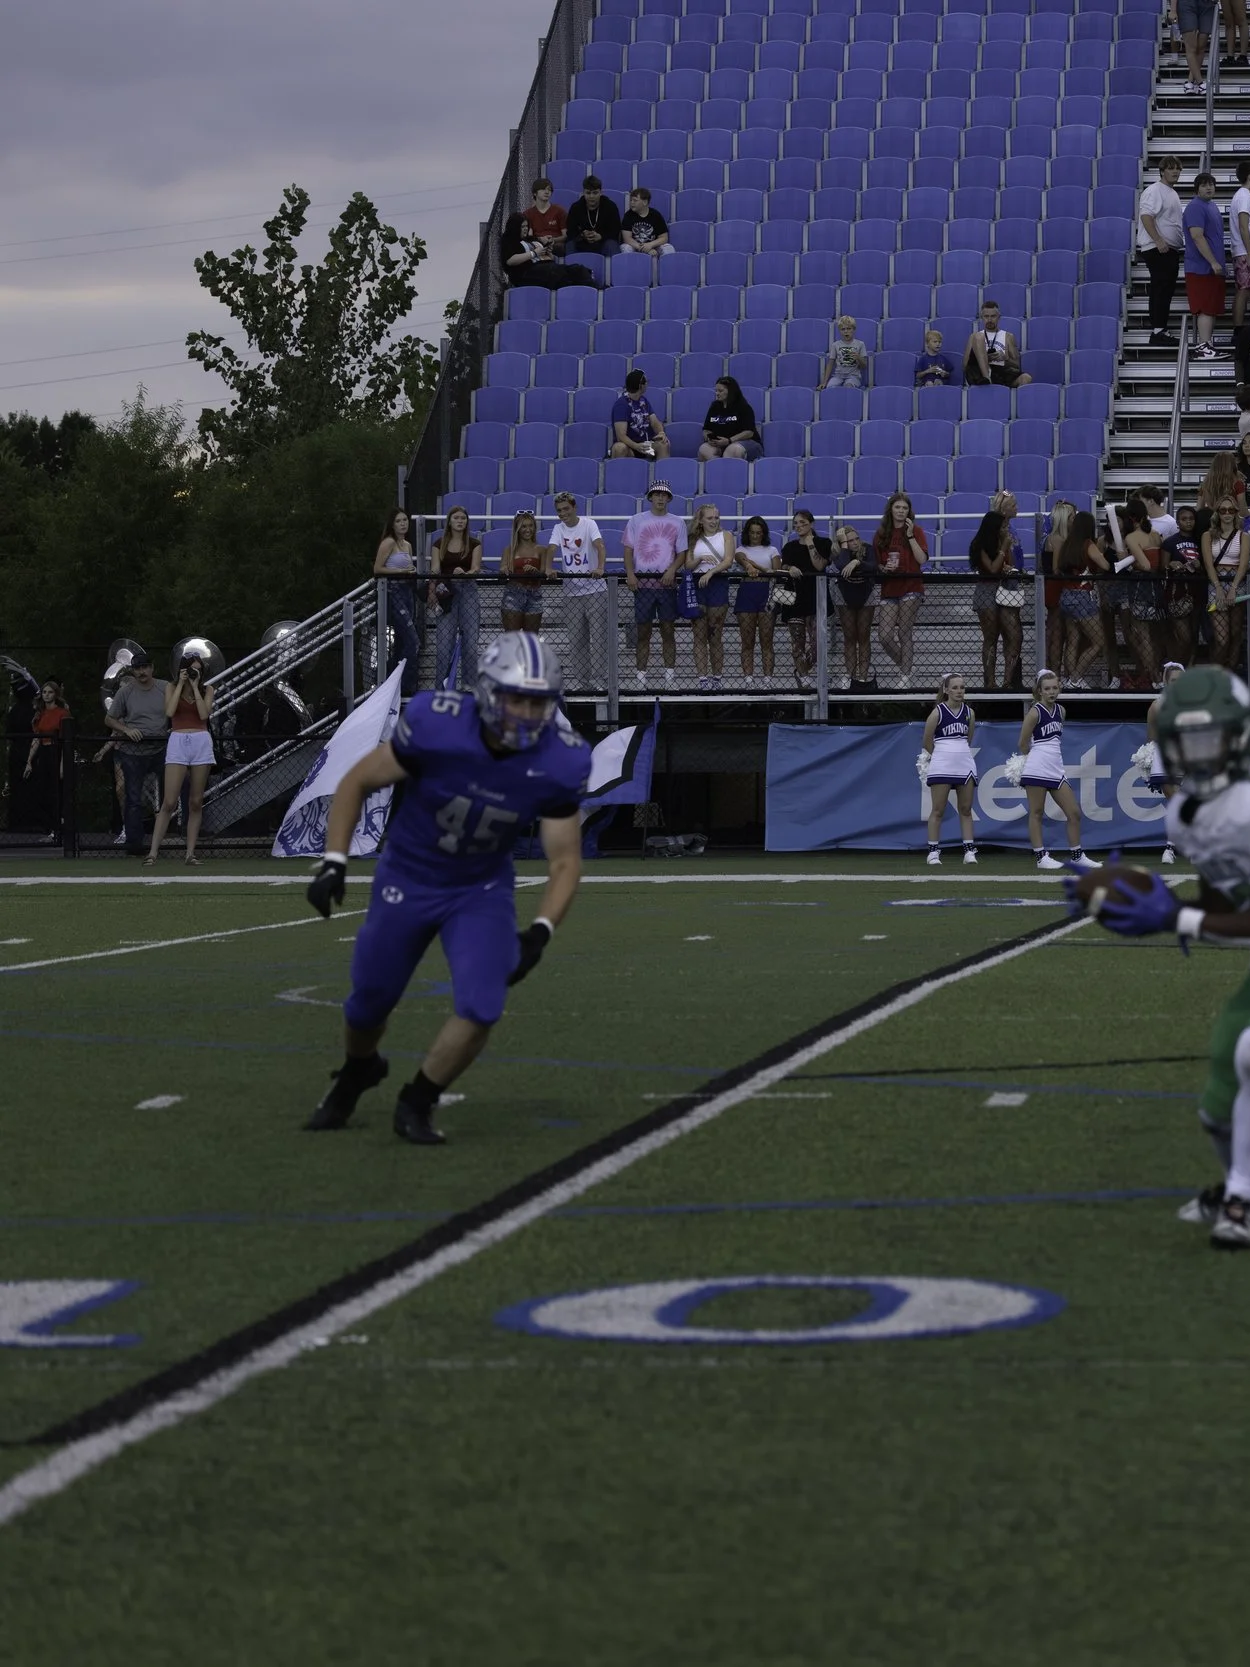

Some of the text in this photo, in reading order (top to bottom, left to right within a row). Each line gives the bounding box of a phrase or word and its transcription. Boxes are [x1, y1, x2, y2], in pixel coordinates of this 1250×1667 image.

[563, 537, 570, 548] I
[564, 553, 589, 566] USA
[942, 722, 969, 737] VIKING
[435, 795, 519, 856] 45
